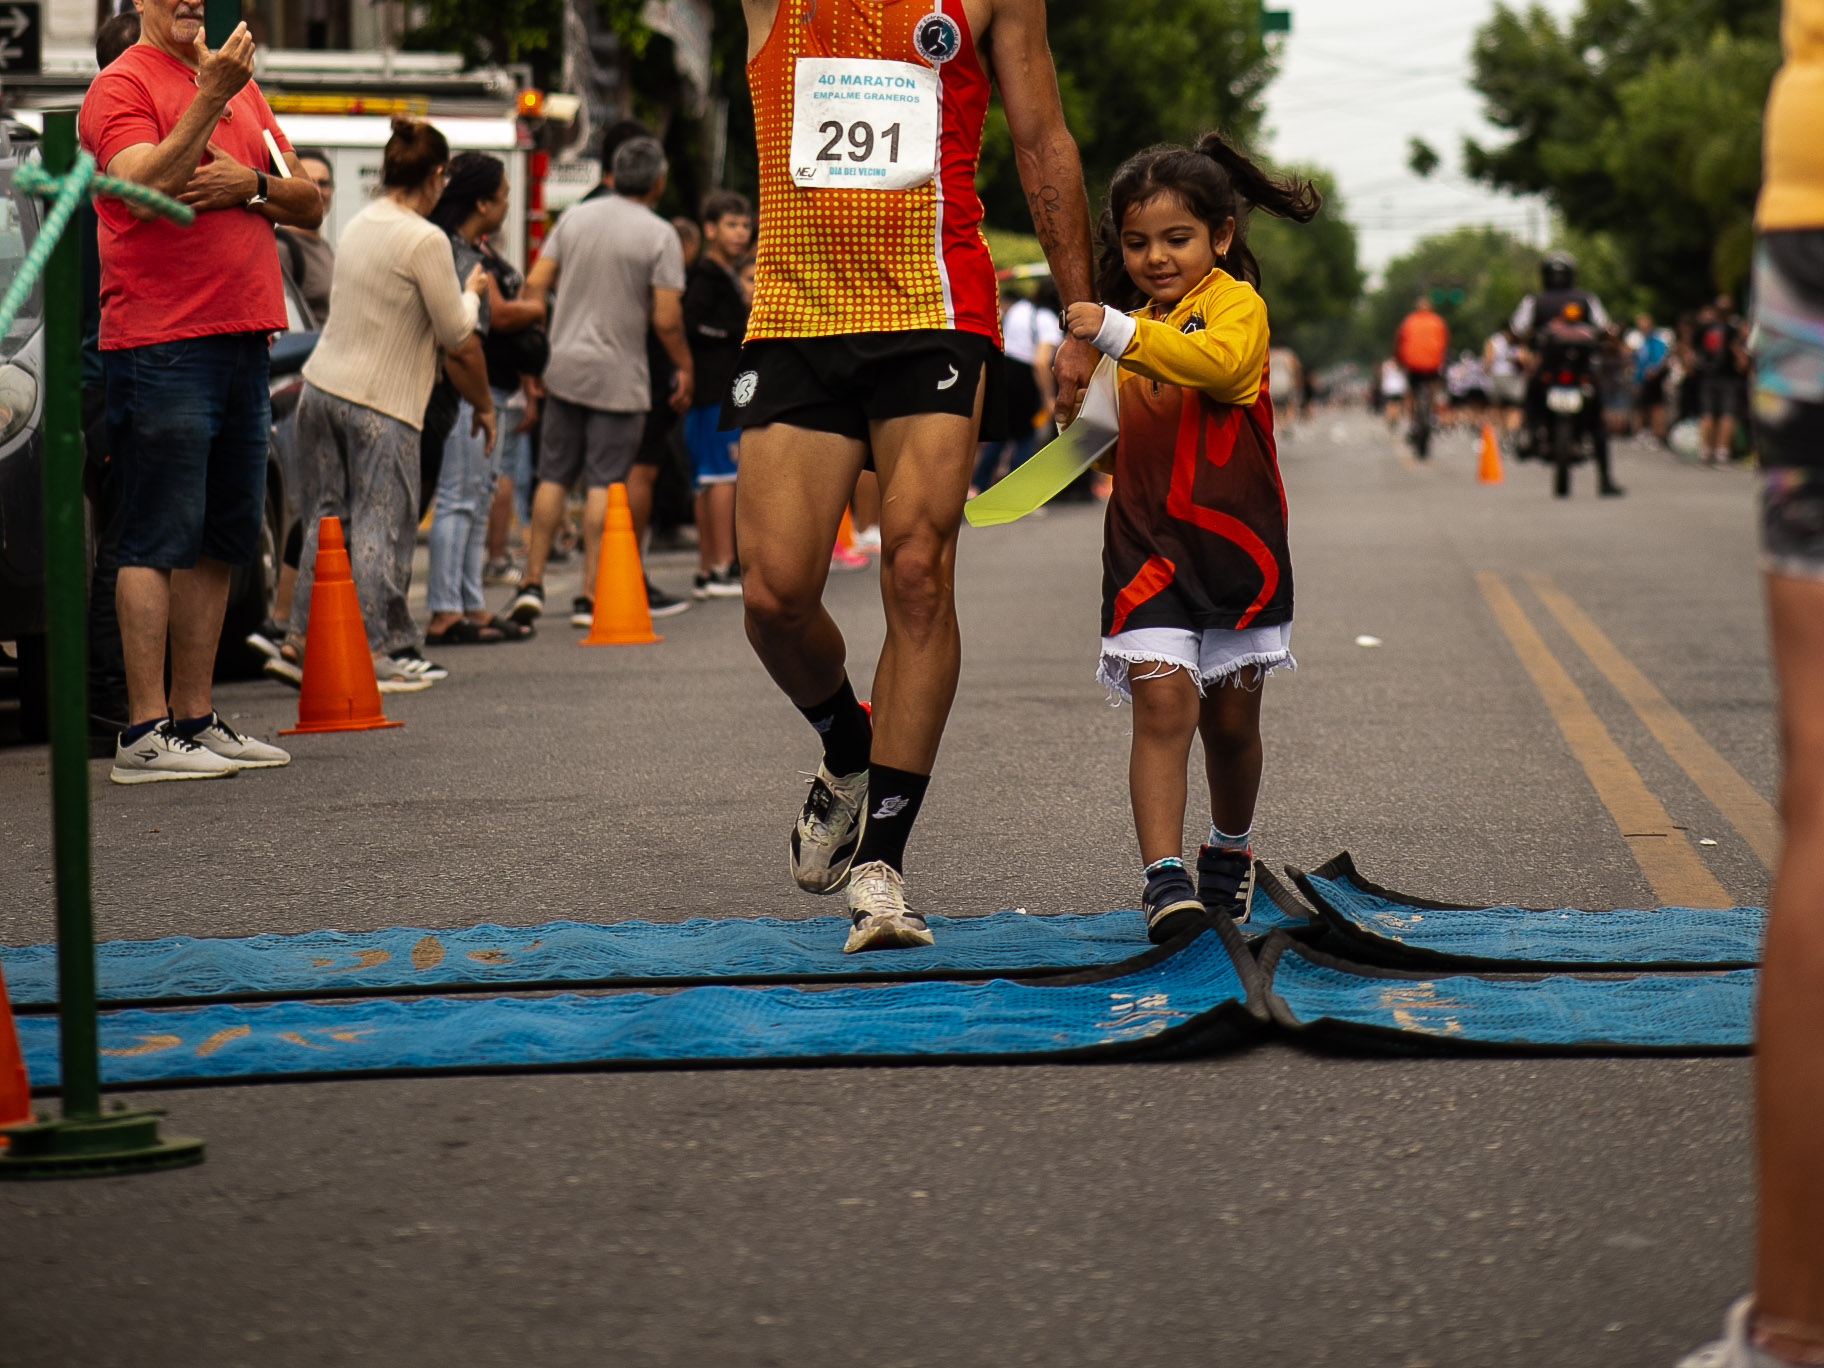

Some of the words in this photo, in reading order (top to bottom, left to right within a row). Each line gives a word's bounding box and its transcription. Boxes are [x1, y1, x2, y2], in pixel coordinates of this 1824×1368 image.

[818, 74, 835, 85] 40
[840, 74, 916, 89] MARATON
[813, 91, 861, 100] EMPALME
[864, 92, 920, 103] GRANEROS
[816, 120, 900, 163] 291
[829, 166, 842, 176] DIA
[844, 167, 857, 176] DEL
[858, 167, 886, 177] VECINO
